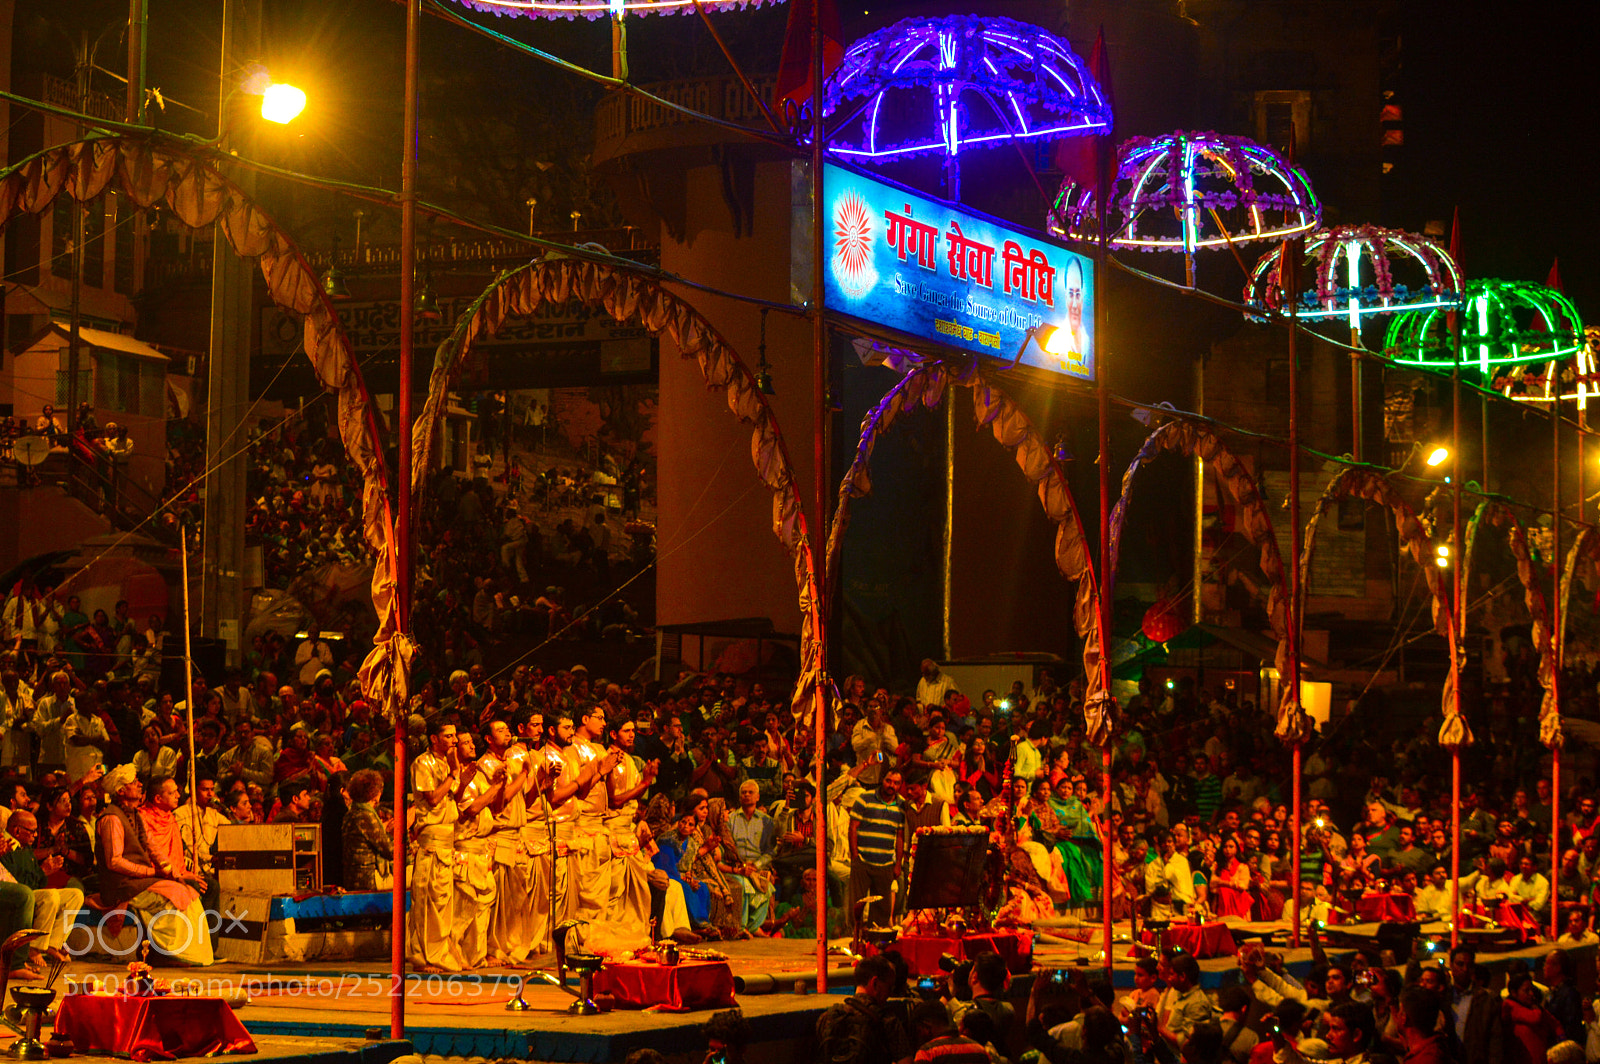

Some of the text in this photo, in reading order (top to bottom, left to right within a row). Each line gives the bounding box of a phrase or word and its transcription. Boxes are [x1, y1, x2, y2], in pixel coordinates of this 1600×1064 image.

[884, 203, 938, 271] गंगा
[946, 220, 995, 289] सेवा
[1002, 239, 1056, 308] निधि
[895, 272, 917, 298] Save
[919, 280, 949, 311] Ganga
[950, 290, 965, 313] the
[966, 294, 998, 322] Source
[999, 305, 1009, 326] of
[1009, 307, 1027, 330] Our
[1028, 312, 1042, 329] Lif
